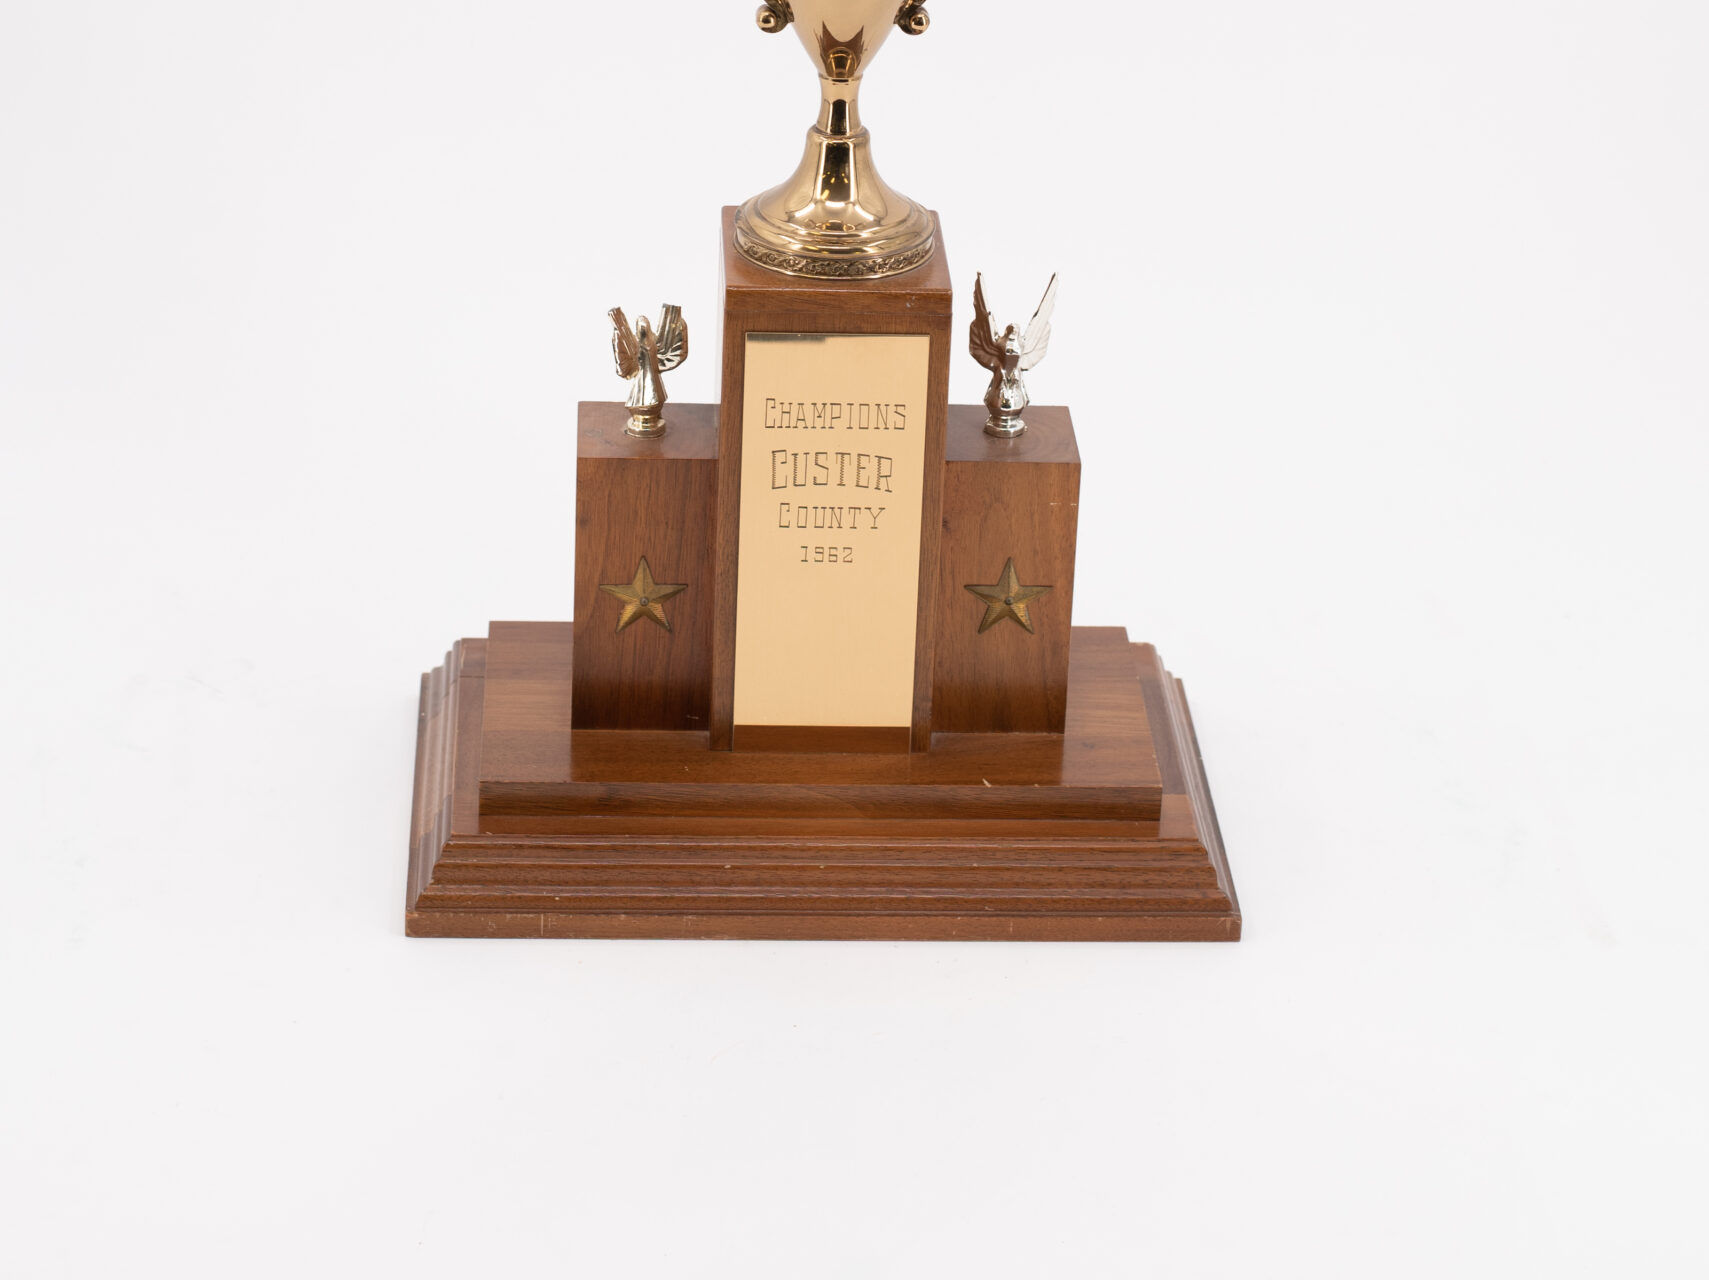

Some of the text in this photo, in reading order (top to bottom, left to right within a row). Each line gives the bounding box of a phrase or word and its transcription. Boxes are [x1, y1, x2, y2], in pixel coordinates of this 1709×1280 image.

[765, 398, 906, 430] CHAMPIONS
[771, 449, 893, 493] CUSTER
[779, 502, 886, 529] COUNTY
[800, 545, 853, 563] 1962
